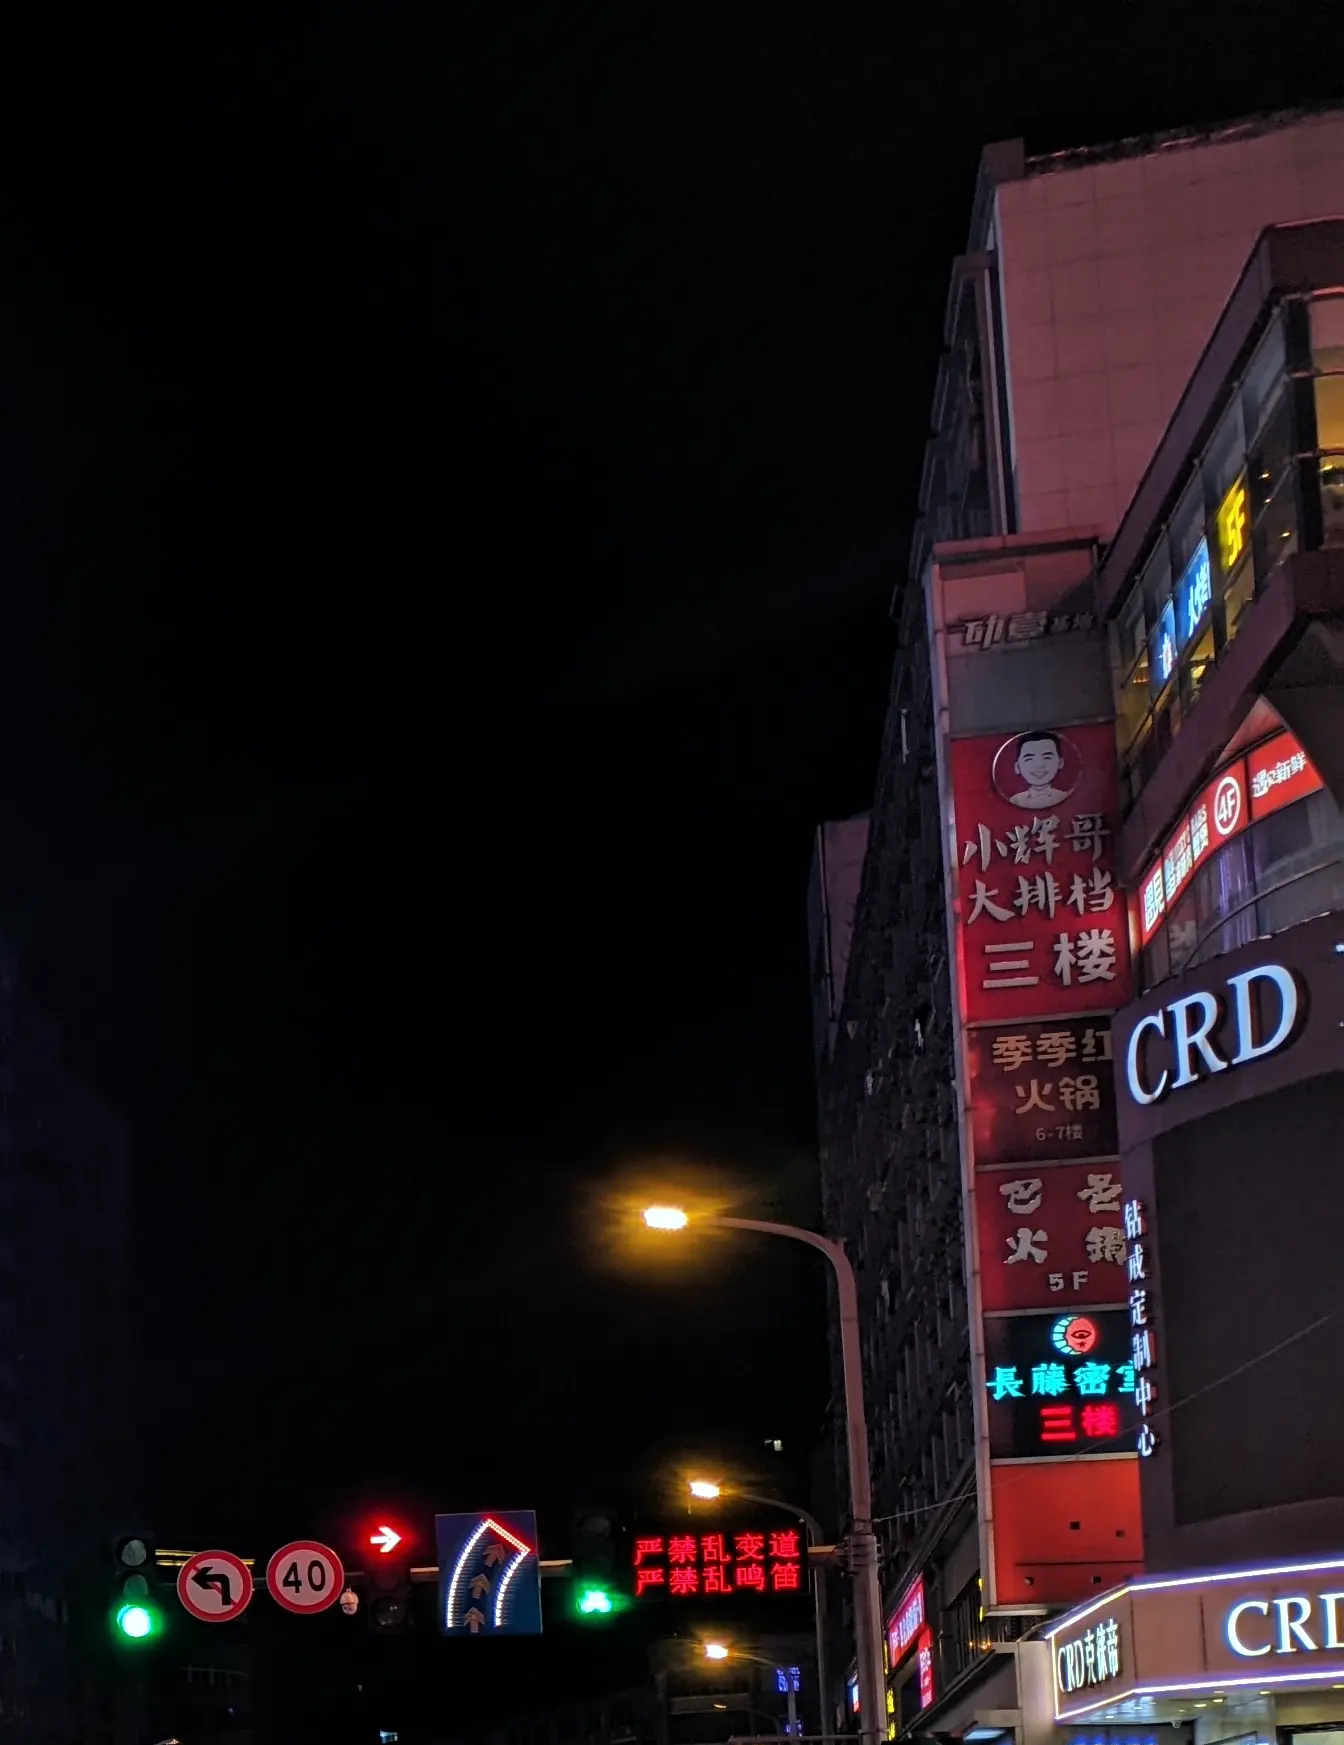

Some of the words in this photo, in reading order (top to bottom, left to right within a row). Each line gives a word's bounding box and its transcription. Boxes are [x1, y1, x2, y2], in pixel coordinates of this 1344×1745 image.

[1218, 787, 1236, 824] 4F
[963, 812, 1112, 873] 小辉哥
[965, 866, 1116, 926] 大排档
[981, 928, 1118, 991] 三楼
[991, 1027, 1112, 1070] 季季红
[1126, 964, 1299, 1106] CRD
[1014, 1074, 1101, 1116] 火锅
[1035, 1123, 1085, 1143] 6-7楼
[1122, 1199, 1156, 1459] 钻戒定制中心
[1039, 1405, 1119, 1442] 三楼
[633, 1530, 801, 1566] 严禁乱变道
[281, 1558, 329, 1595] 40
[635, 1562, 801, 1596] 严禁乱鸣笛
